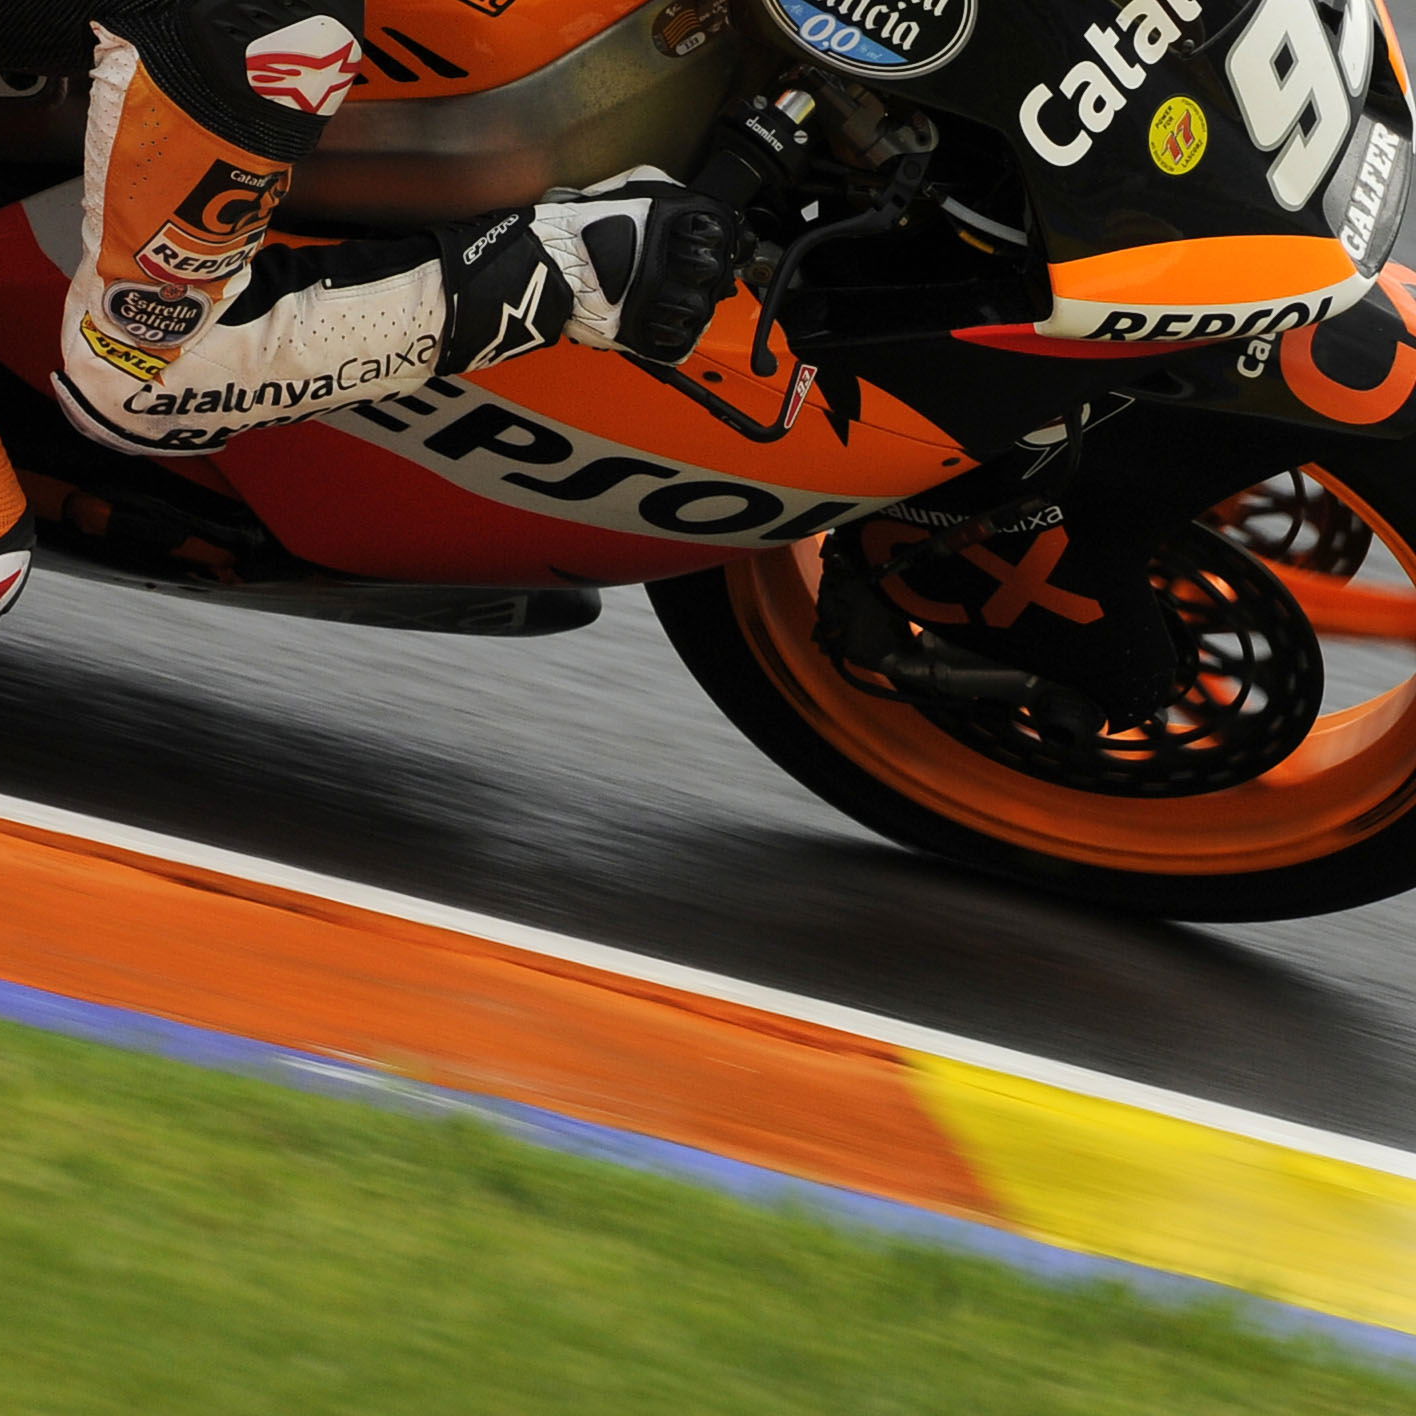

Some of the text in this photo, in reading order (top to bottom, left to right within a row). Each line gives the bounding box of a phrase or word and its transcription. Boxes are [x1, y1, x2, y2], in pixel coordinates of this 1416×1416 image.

[799, 13, 862, 52] 0,0
[745, 116, 784, 152] domino
[1161, 108, 1195, 166] 17
[1339, 121, 1401, 261] GALFER
[119, 300, 186, 333] Galicia
[123, 290, 198, 321] Estrella
[123, 333, 438, 417] CatalunyaCaixa
